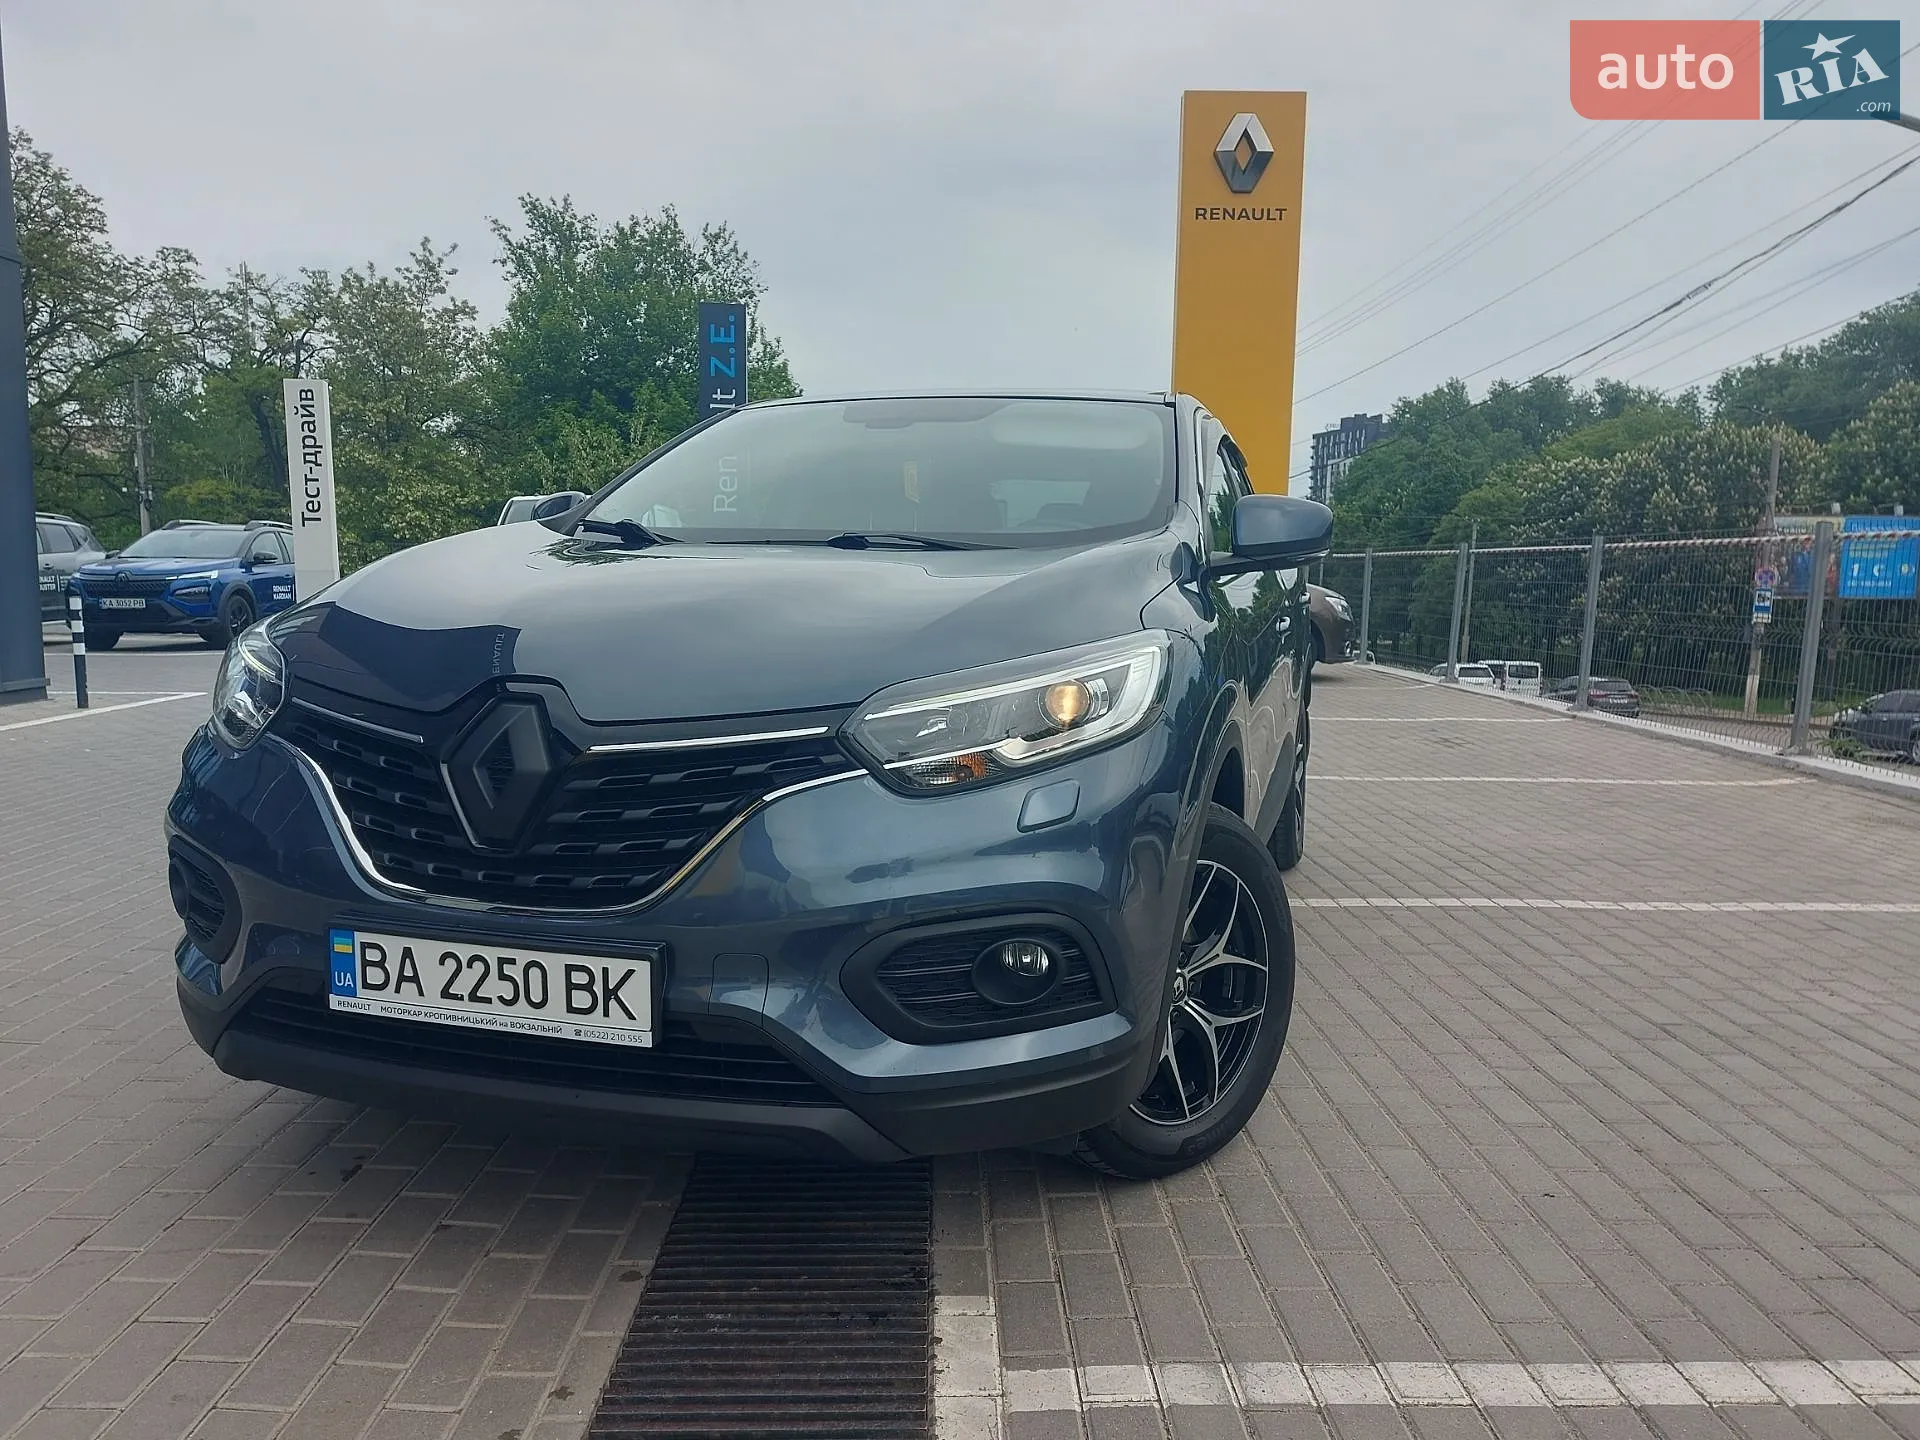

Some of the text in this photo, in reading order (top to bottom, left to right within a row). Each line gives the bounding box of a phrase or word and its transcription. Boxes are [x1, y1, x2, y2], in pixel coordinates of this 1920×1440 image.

[1195, 207, 1288, 221] RENAULT
[709, 315, 737, 378] Z.E.
[294, 388, 323, 527] Тест-драйв
[335, 971, 354, 988] UA
[359, 941, 637, 1021] BA 2250 BK
[337, 1000, 371, 1011] RENAULT
[380, 1005, 563, 1035] МОТОРКАР КРОПИВНИЦЬКИЙ на ВОКЗАЛЬНІЙ
[583, 1029, 643, 1044] (0522) 210 555
